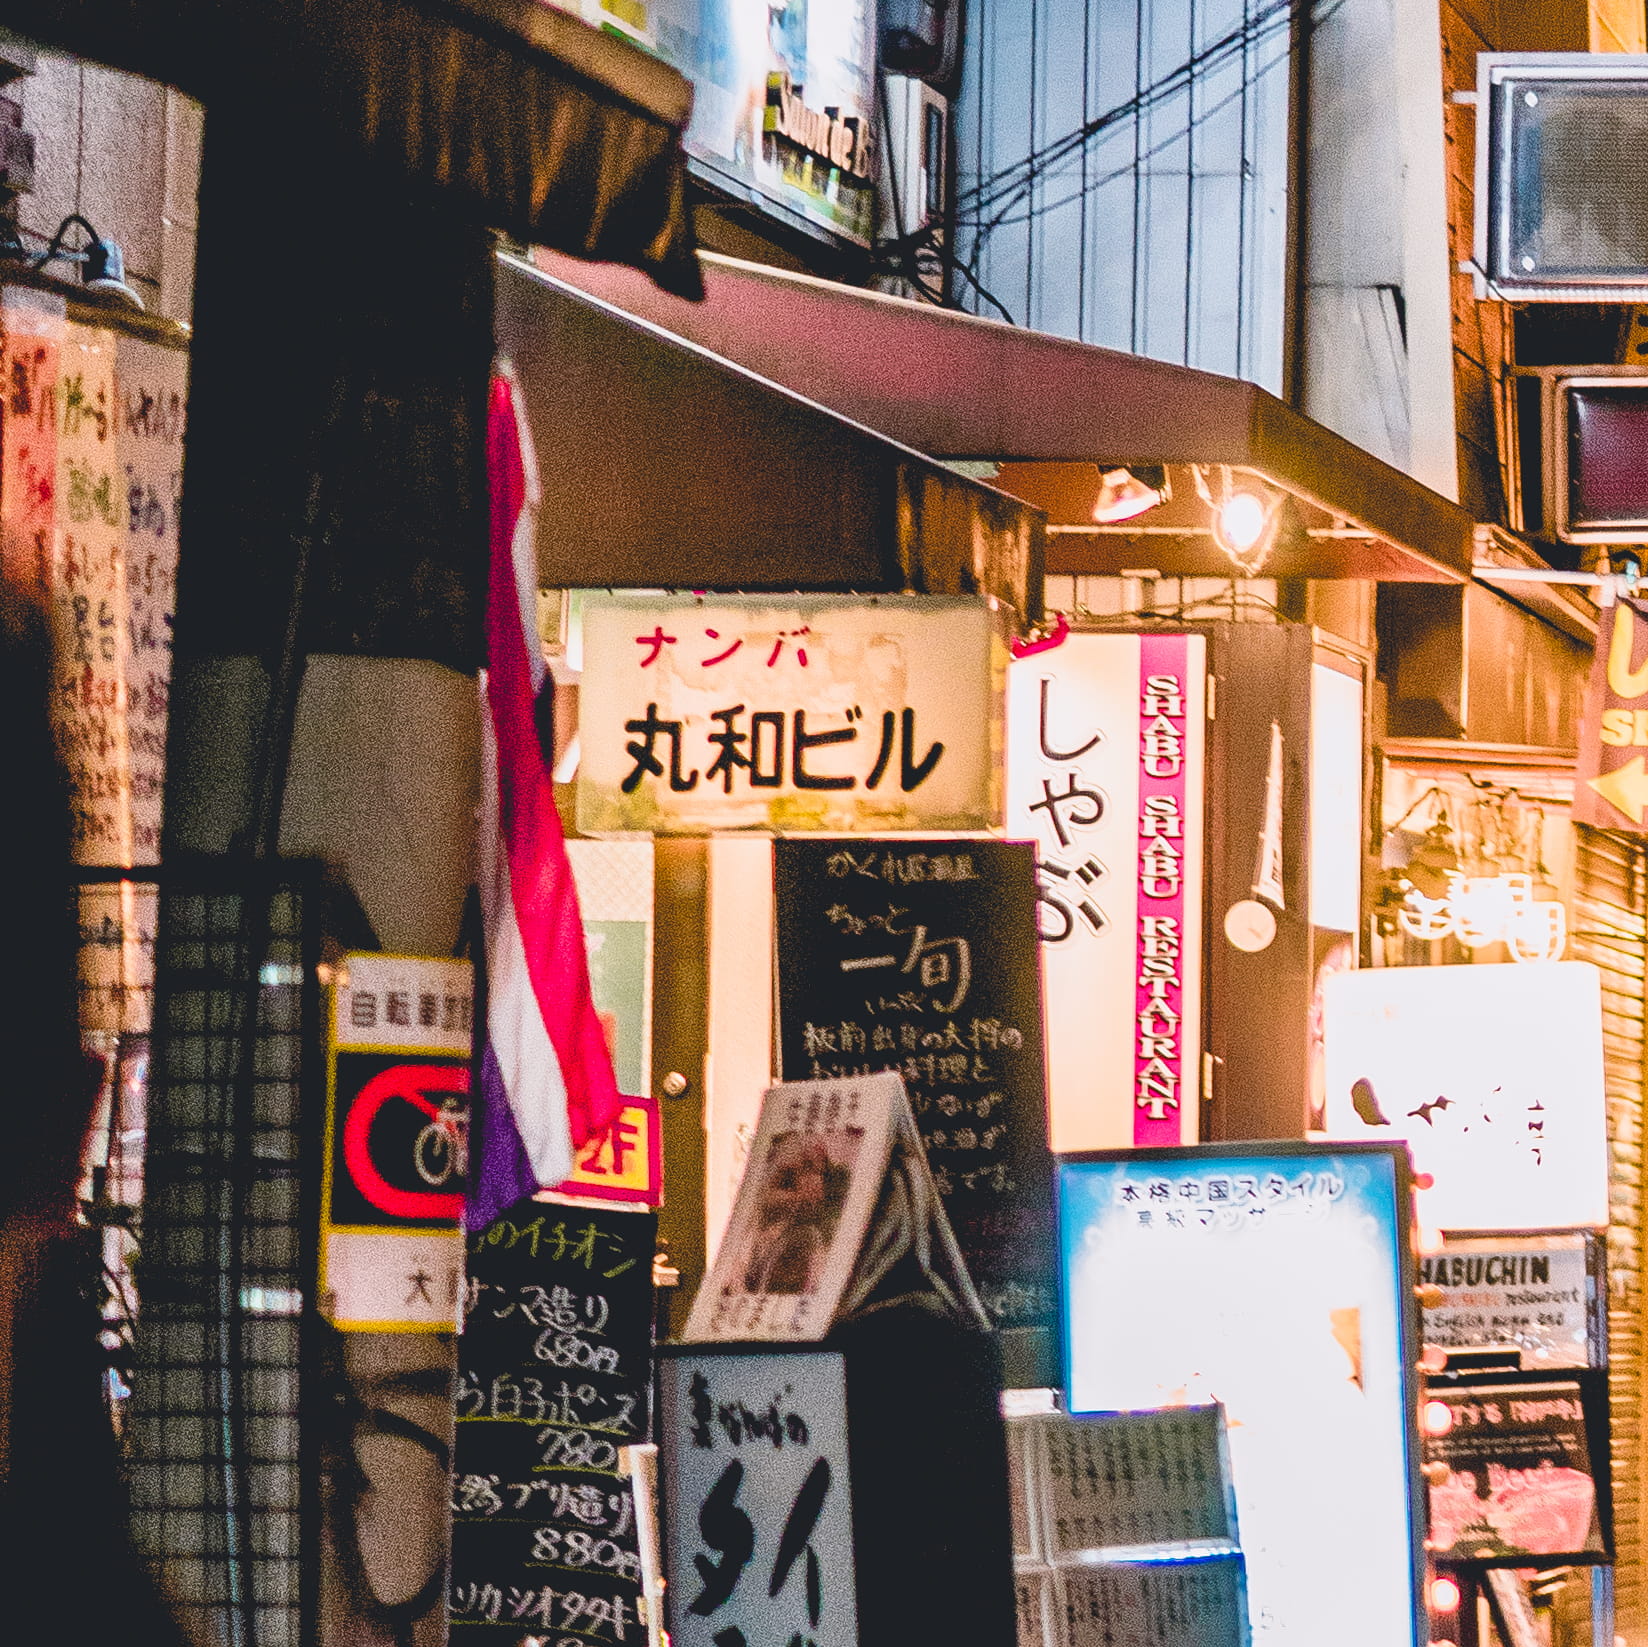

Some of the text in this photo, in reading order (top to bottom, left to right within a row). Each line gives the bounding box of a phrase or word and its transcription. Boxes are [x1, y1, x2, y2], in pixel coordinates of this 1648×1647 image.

[635, 625, 811, 668] ナンバ
[620, 702, 946, 794] 丸和ビル
[1136, 674, 1185, 1120] SHABU SHABU RESTAURANT
[477, 1217, 637, 1278] のイチオシ
